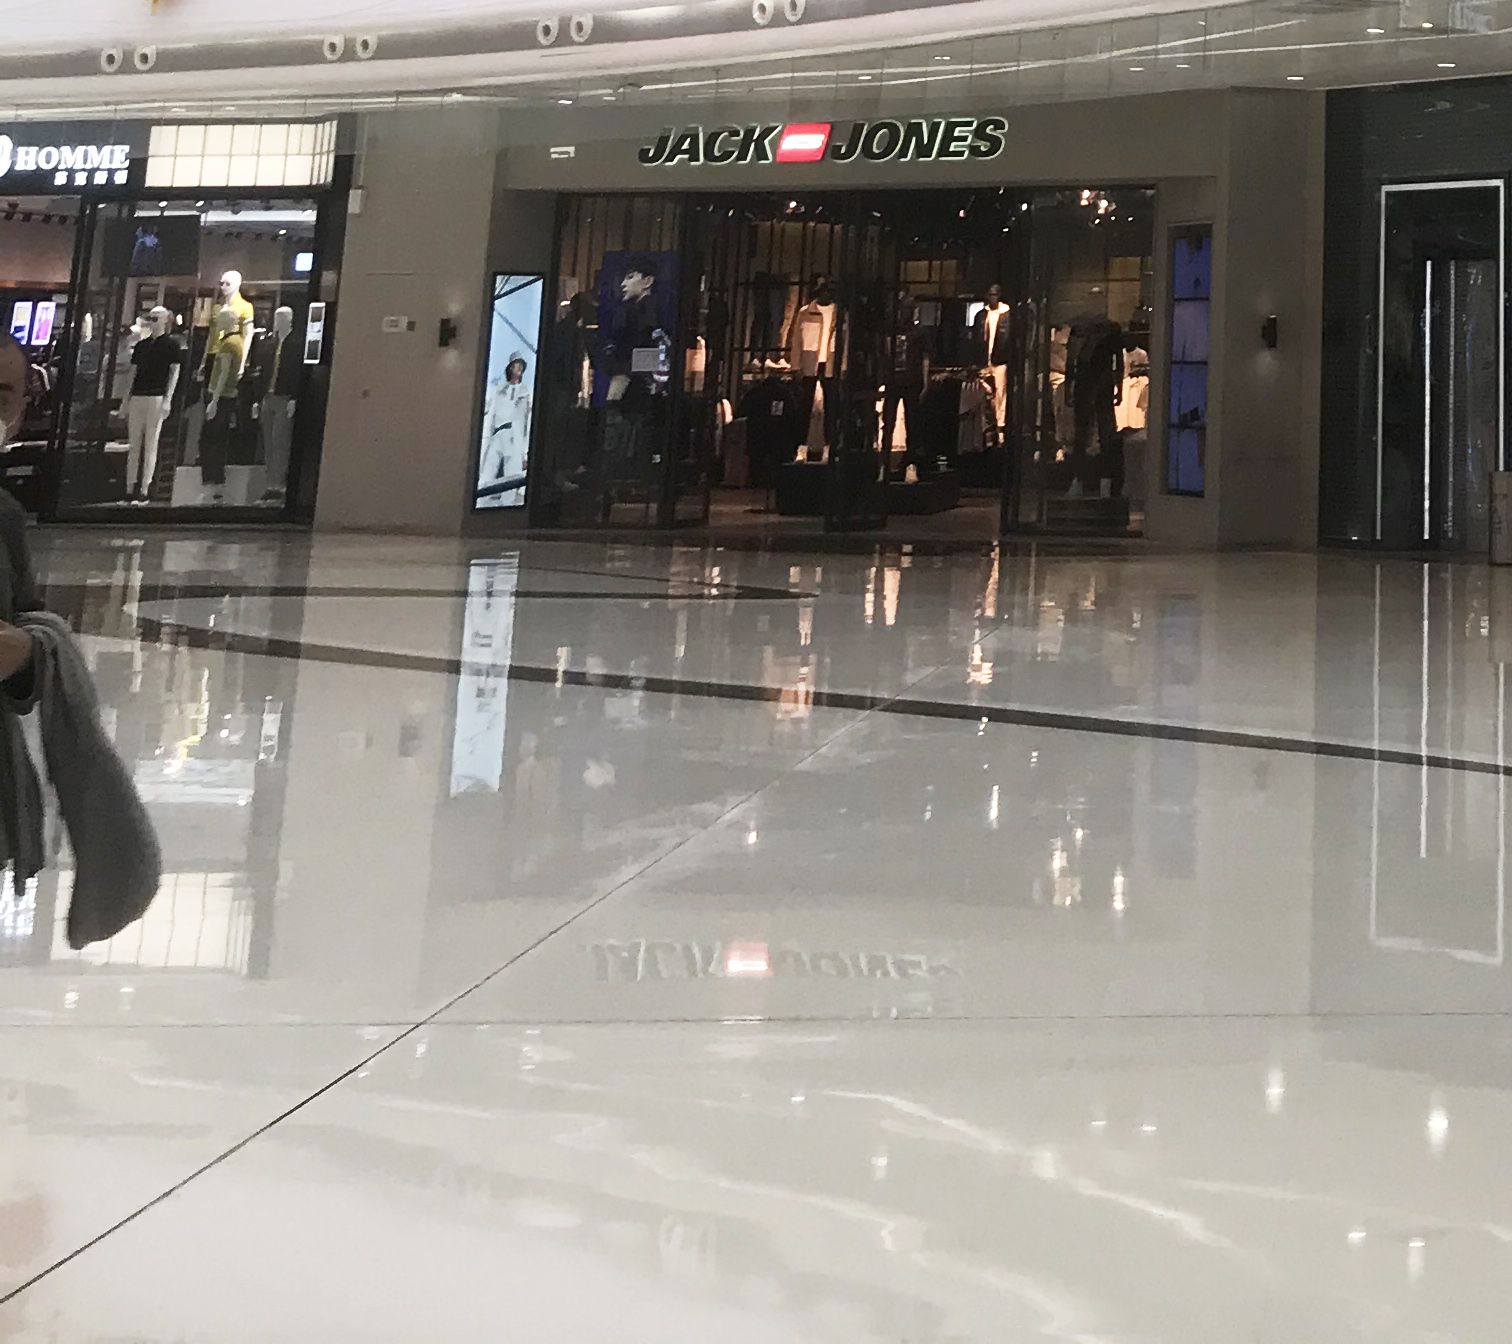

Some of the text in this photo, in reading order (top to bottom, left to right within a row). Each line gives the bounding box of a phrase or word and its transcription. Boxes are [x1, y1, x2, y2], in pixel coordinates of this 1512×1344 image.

[14, 144, 130, 170] HOMME
[638, 116, 1008, 165] JACK JONES
